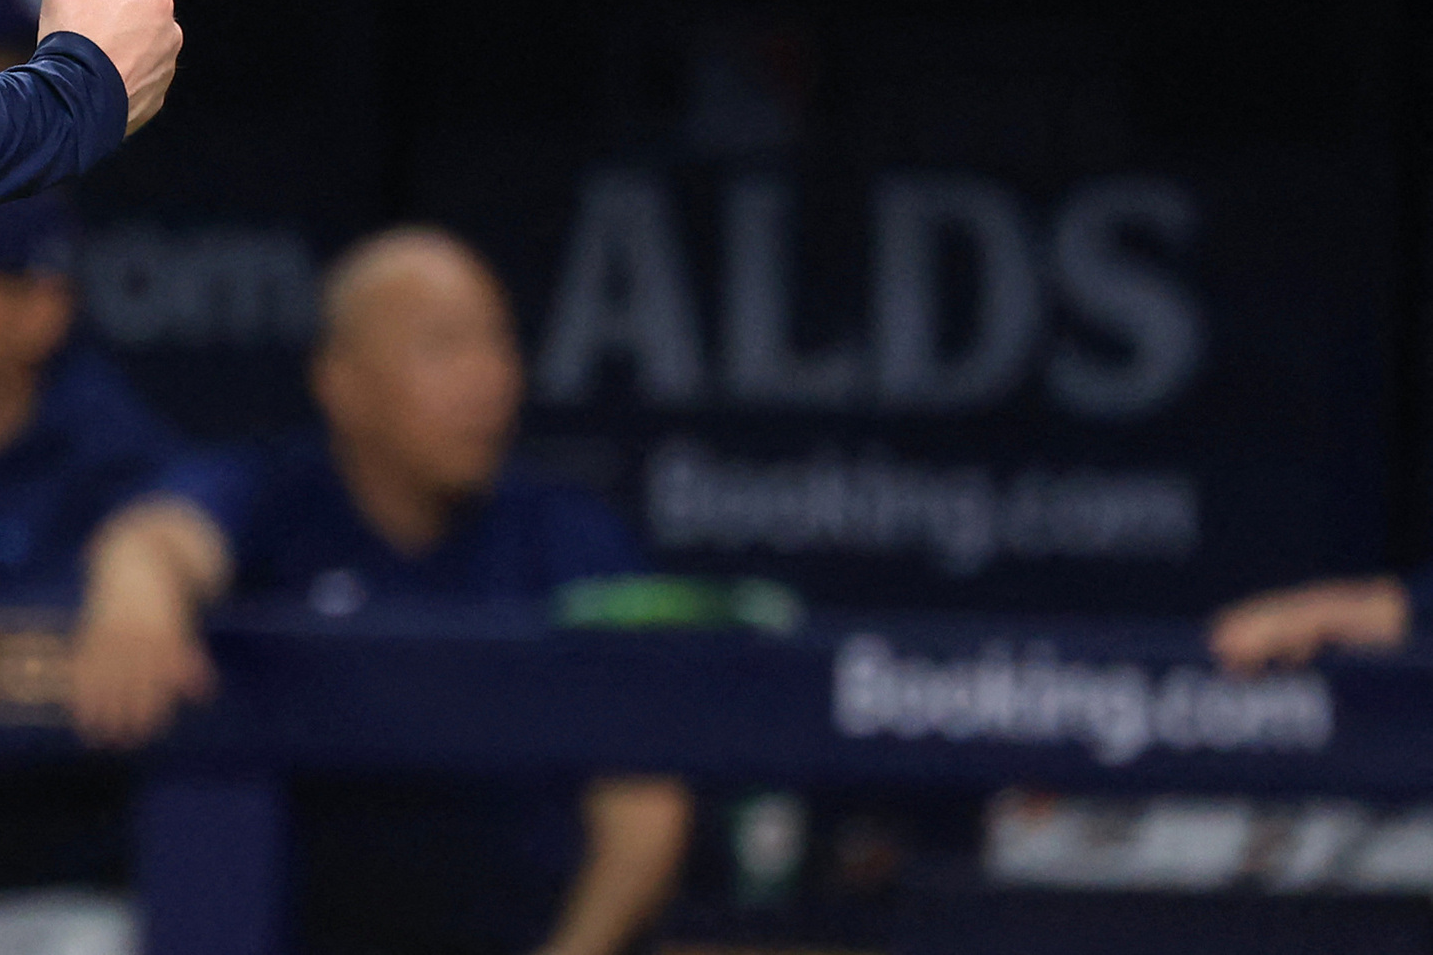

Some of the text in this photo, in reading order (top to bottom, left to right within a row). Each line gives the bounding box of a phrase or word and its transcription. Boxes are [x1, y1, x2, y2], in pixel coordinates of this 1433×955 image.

[539, 169, 1206, 417] ALDS
[647, 444, 1201, 575] Booking.com
[832, 634, 1335, 766] Booking.com
